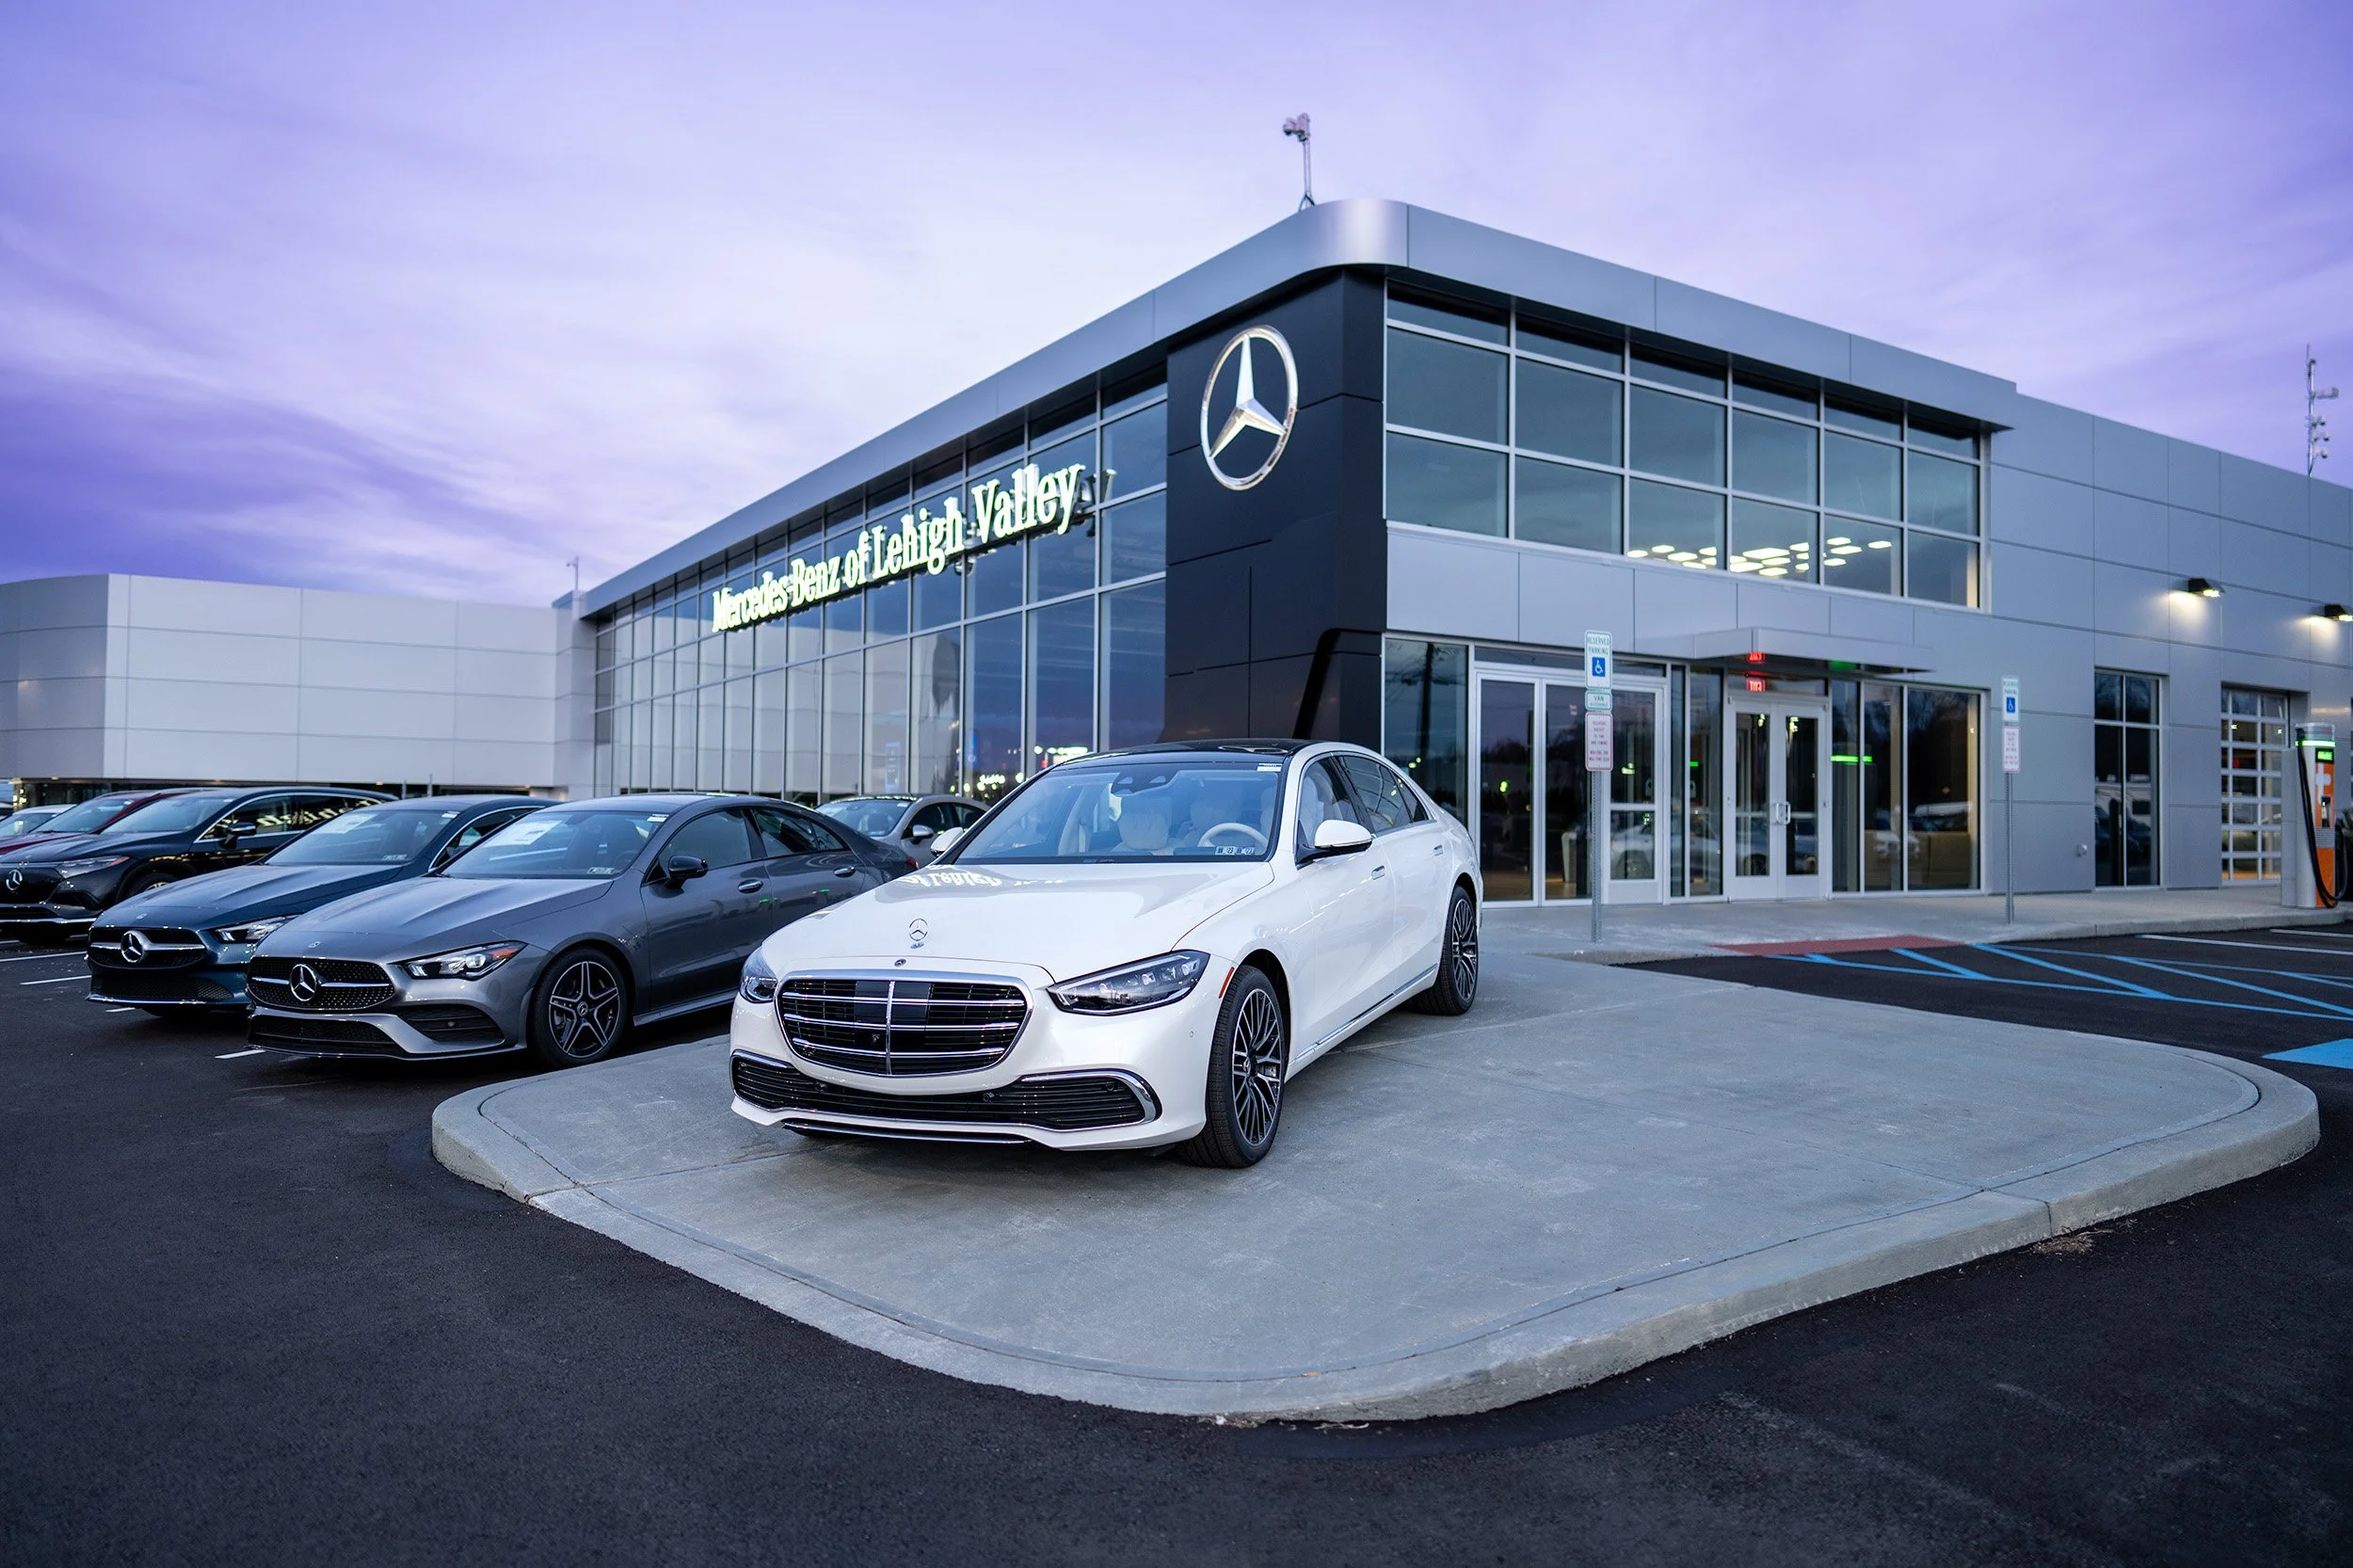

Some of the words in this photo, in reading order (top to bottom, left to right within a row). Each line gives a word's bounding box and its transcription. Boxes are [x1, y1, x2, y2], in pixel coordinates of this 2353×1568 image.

[712, 557, 840, 632] Mercedes-Benz
[844, 530, 871, 585] of
[871, 496, 965, 575] Lehigh
[970, 463, 1086, 544] Valley
[1589, 647, 1609, 655] PARKING
